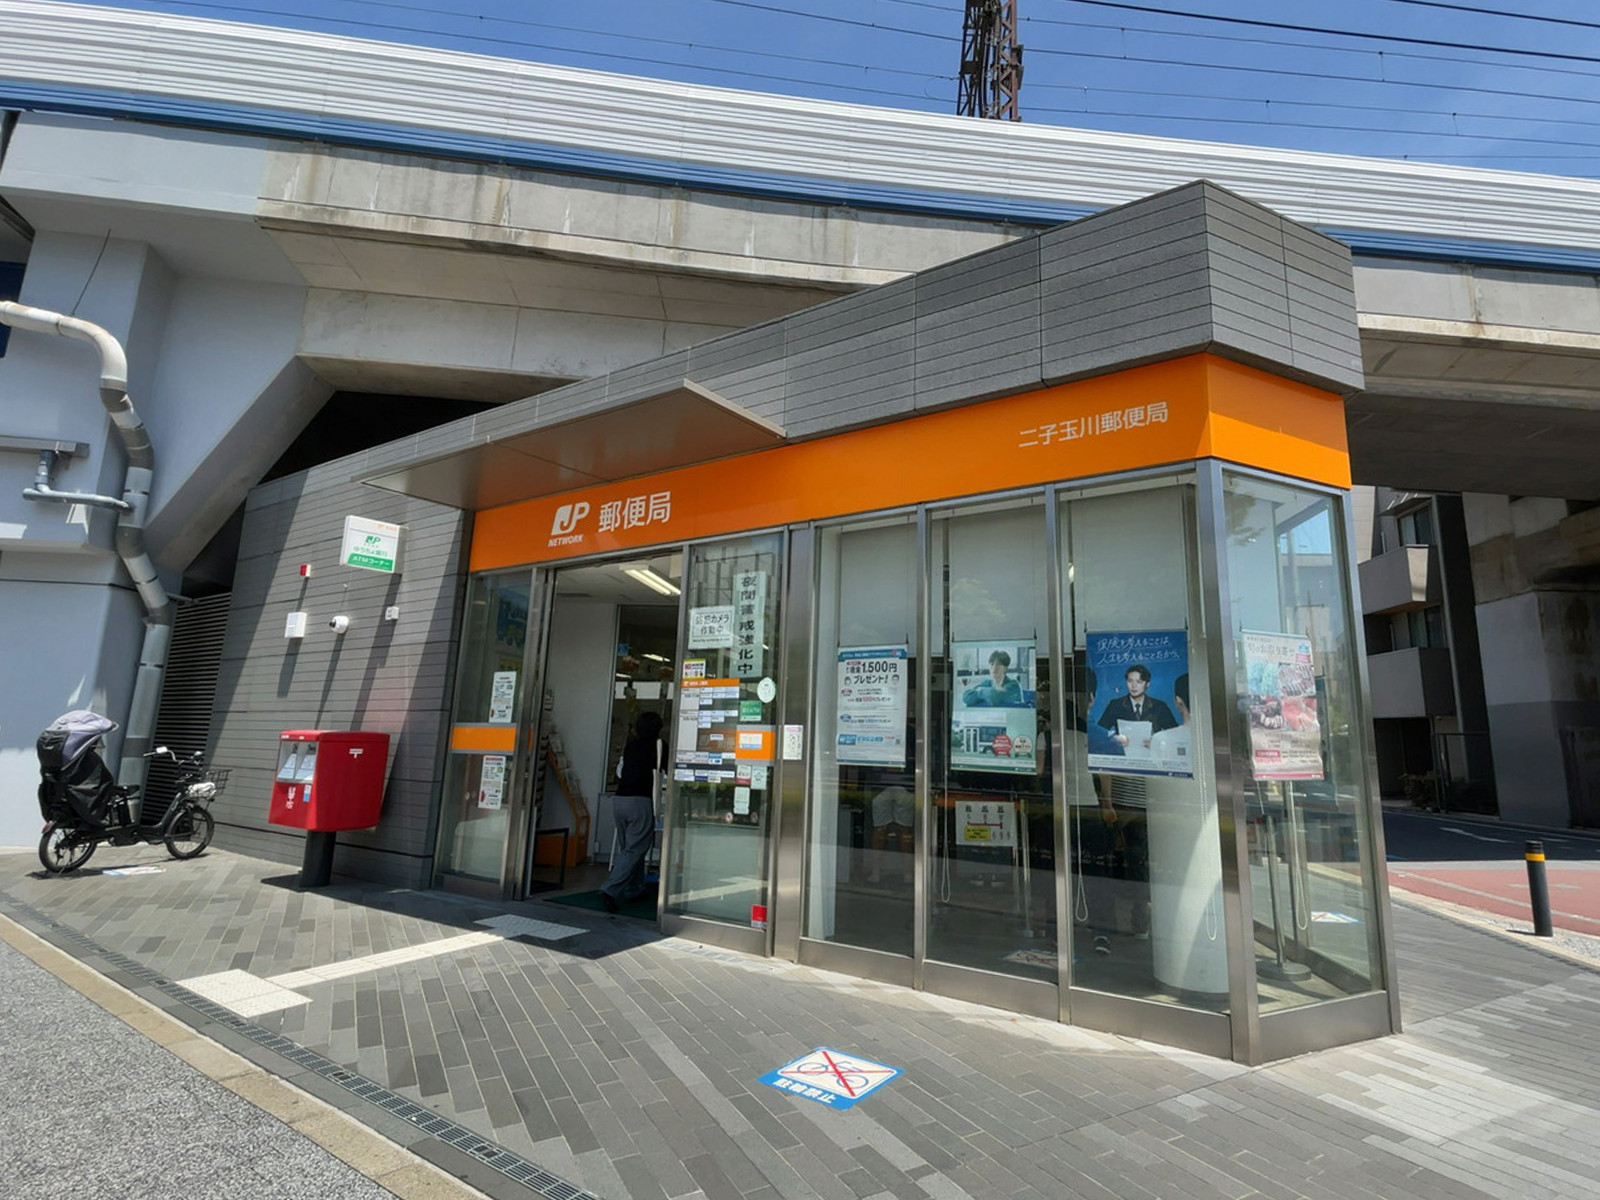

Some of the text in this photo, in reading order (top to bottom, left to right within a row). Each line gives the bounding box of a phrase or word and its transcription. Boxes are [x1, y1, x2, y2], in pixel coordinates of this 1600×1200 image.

[1018, 401, 1168, 447] 二子玉川郵便局
[598, 491, 671, 533] 郵便局
[547, 534, 584, 547] NETWORK
